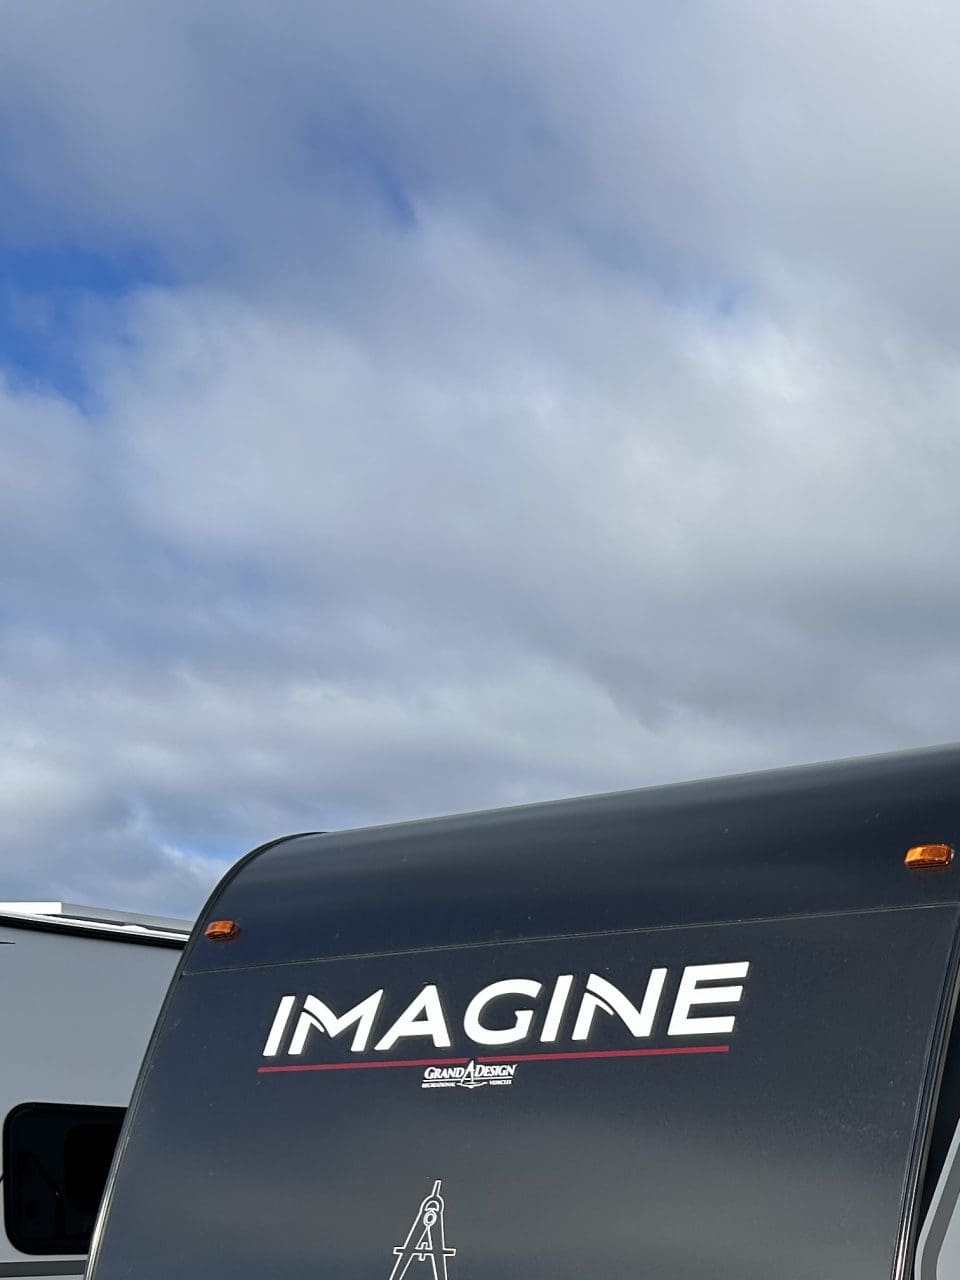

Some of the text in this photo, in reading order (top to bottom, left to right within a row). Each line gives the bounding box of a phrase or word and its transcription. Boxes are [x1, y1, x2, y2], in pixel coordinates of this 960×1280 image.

[262, 961, 750, 1057] IMAGINE
[424, 1064, 517, 1079] GRAND DESIGN
